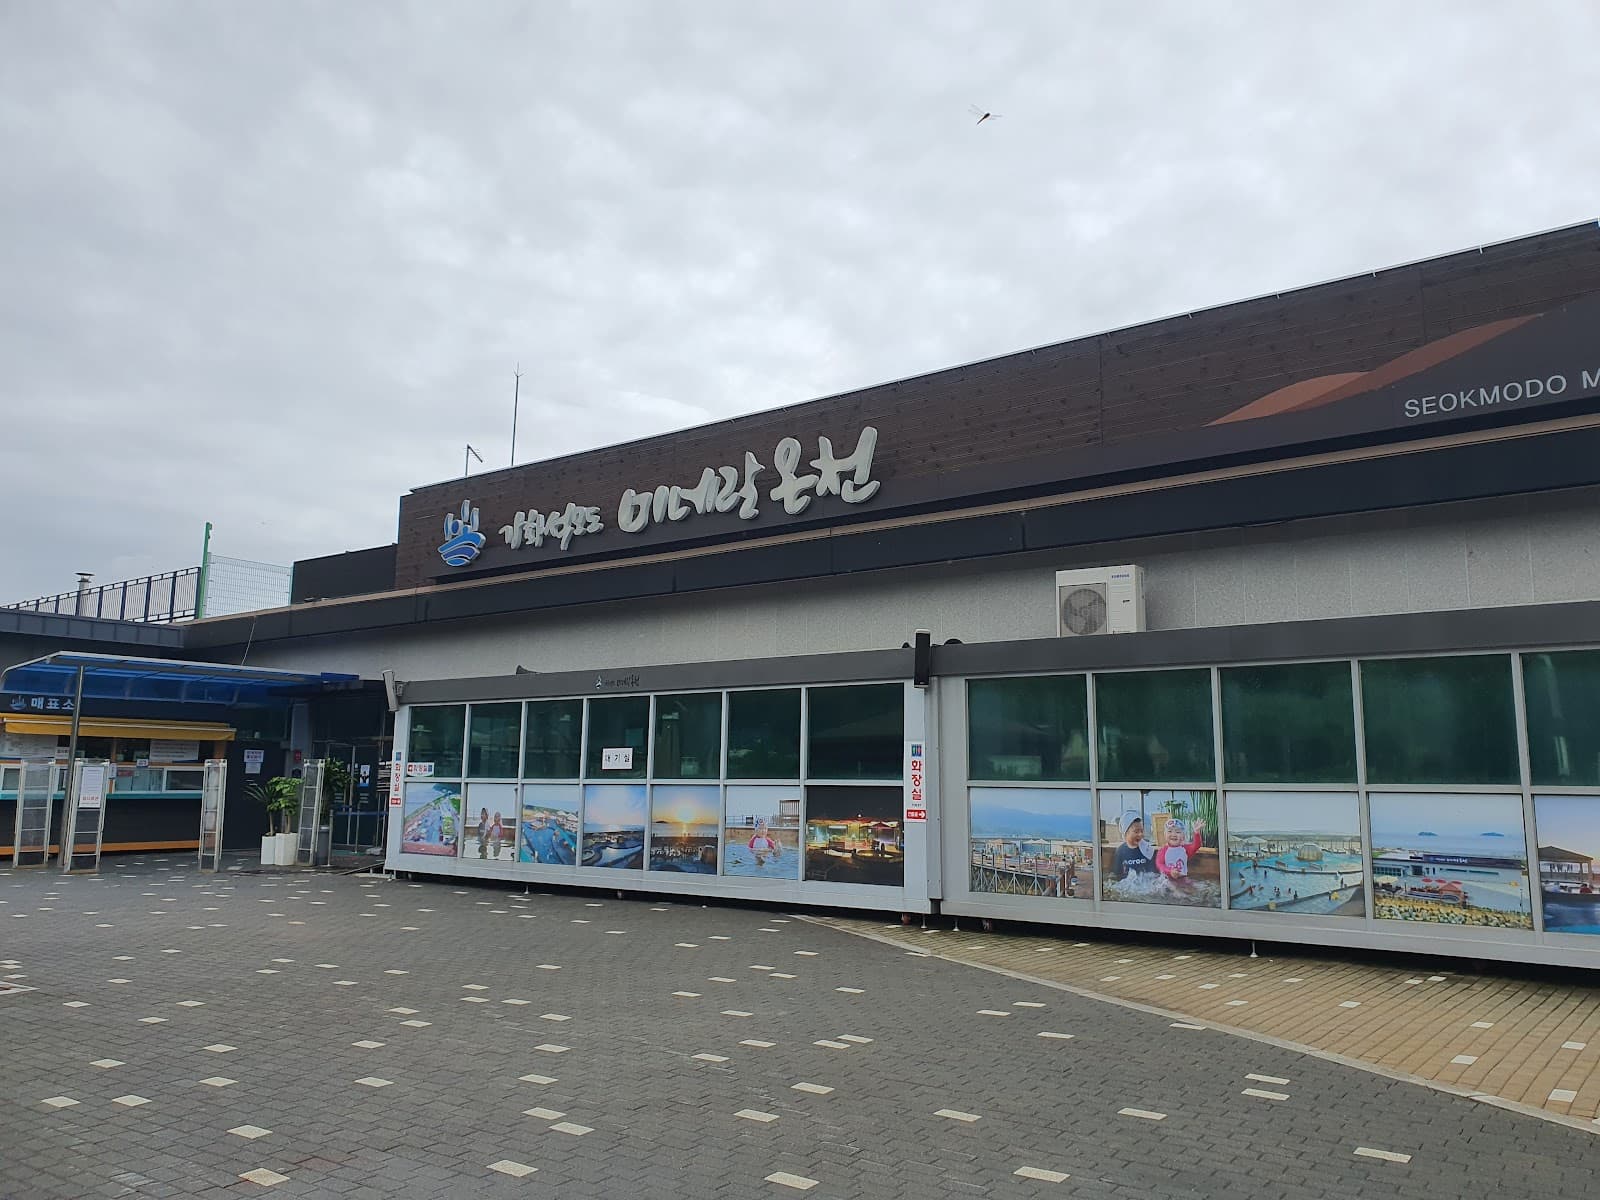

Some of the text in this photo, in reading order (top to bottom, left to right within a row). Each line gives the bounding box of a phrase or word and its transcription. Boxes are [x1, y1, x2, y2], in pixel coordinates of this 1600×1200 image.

[1404, 374, 1567, 418] SEOKMODO
[617, 450, 766, 533] 미네랄
[769, 426, 881, 515] 온천
[31, 697, 75, 710] 매표소
[910, 759, 923, 801] 화장실
